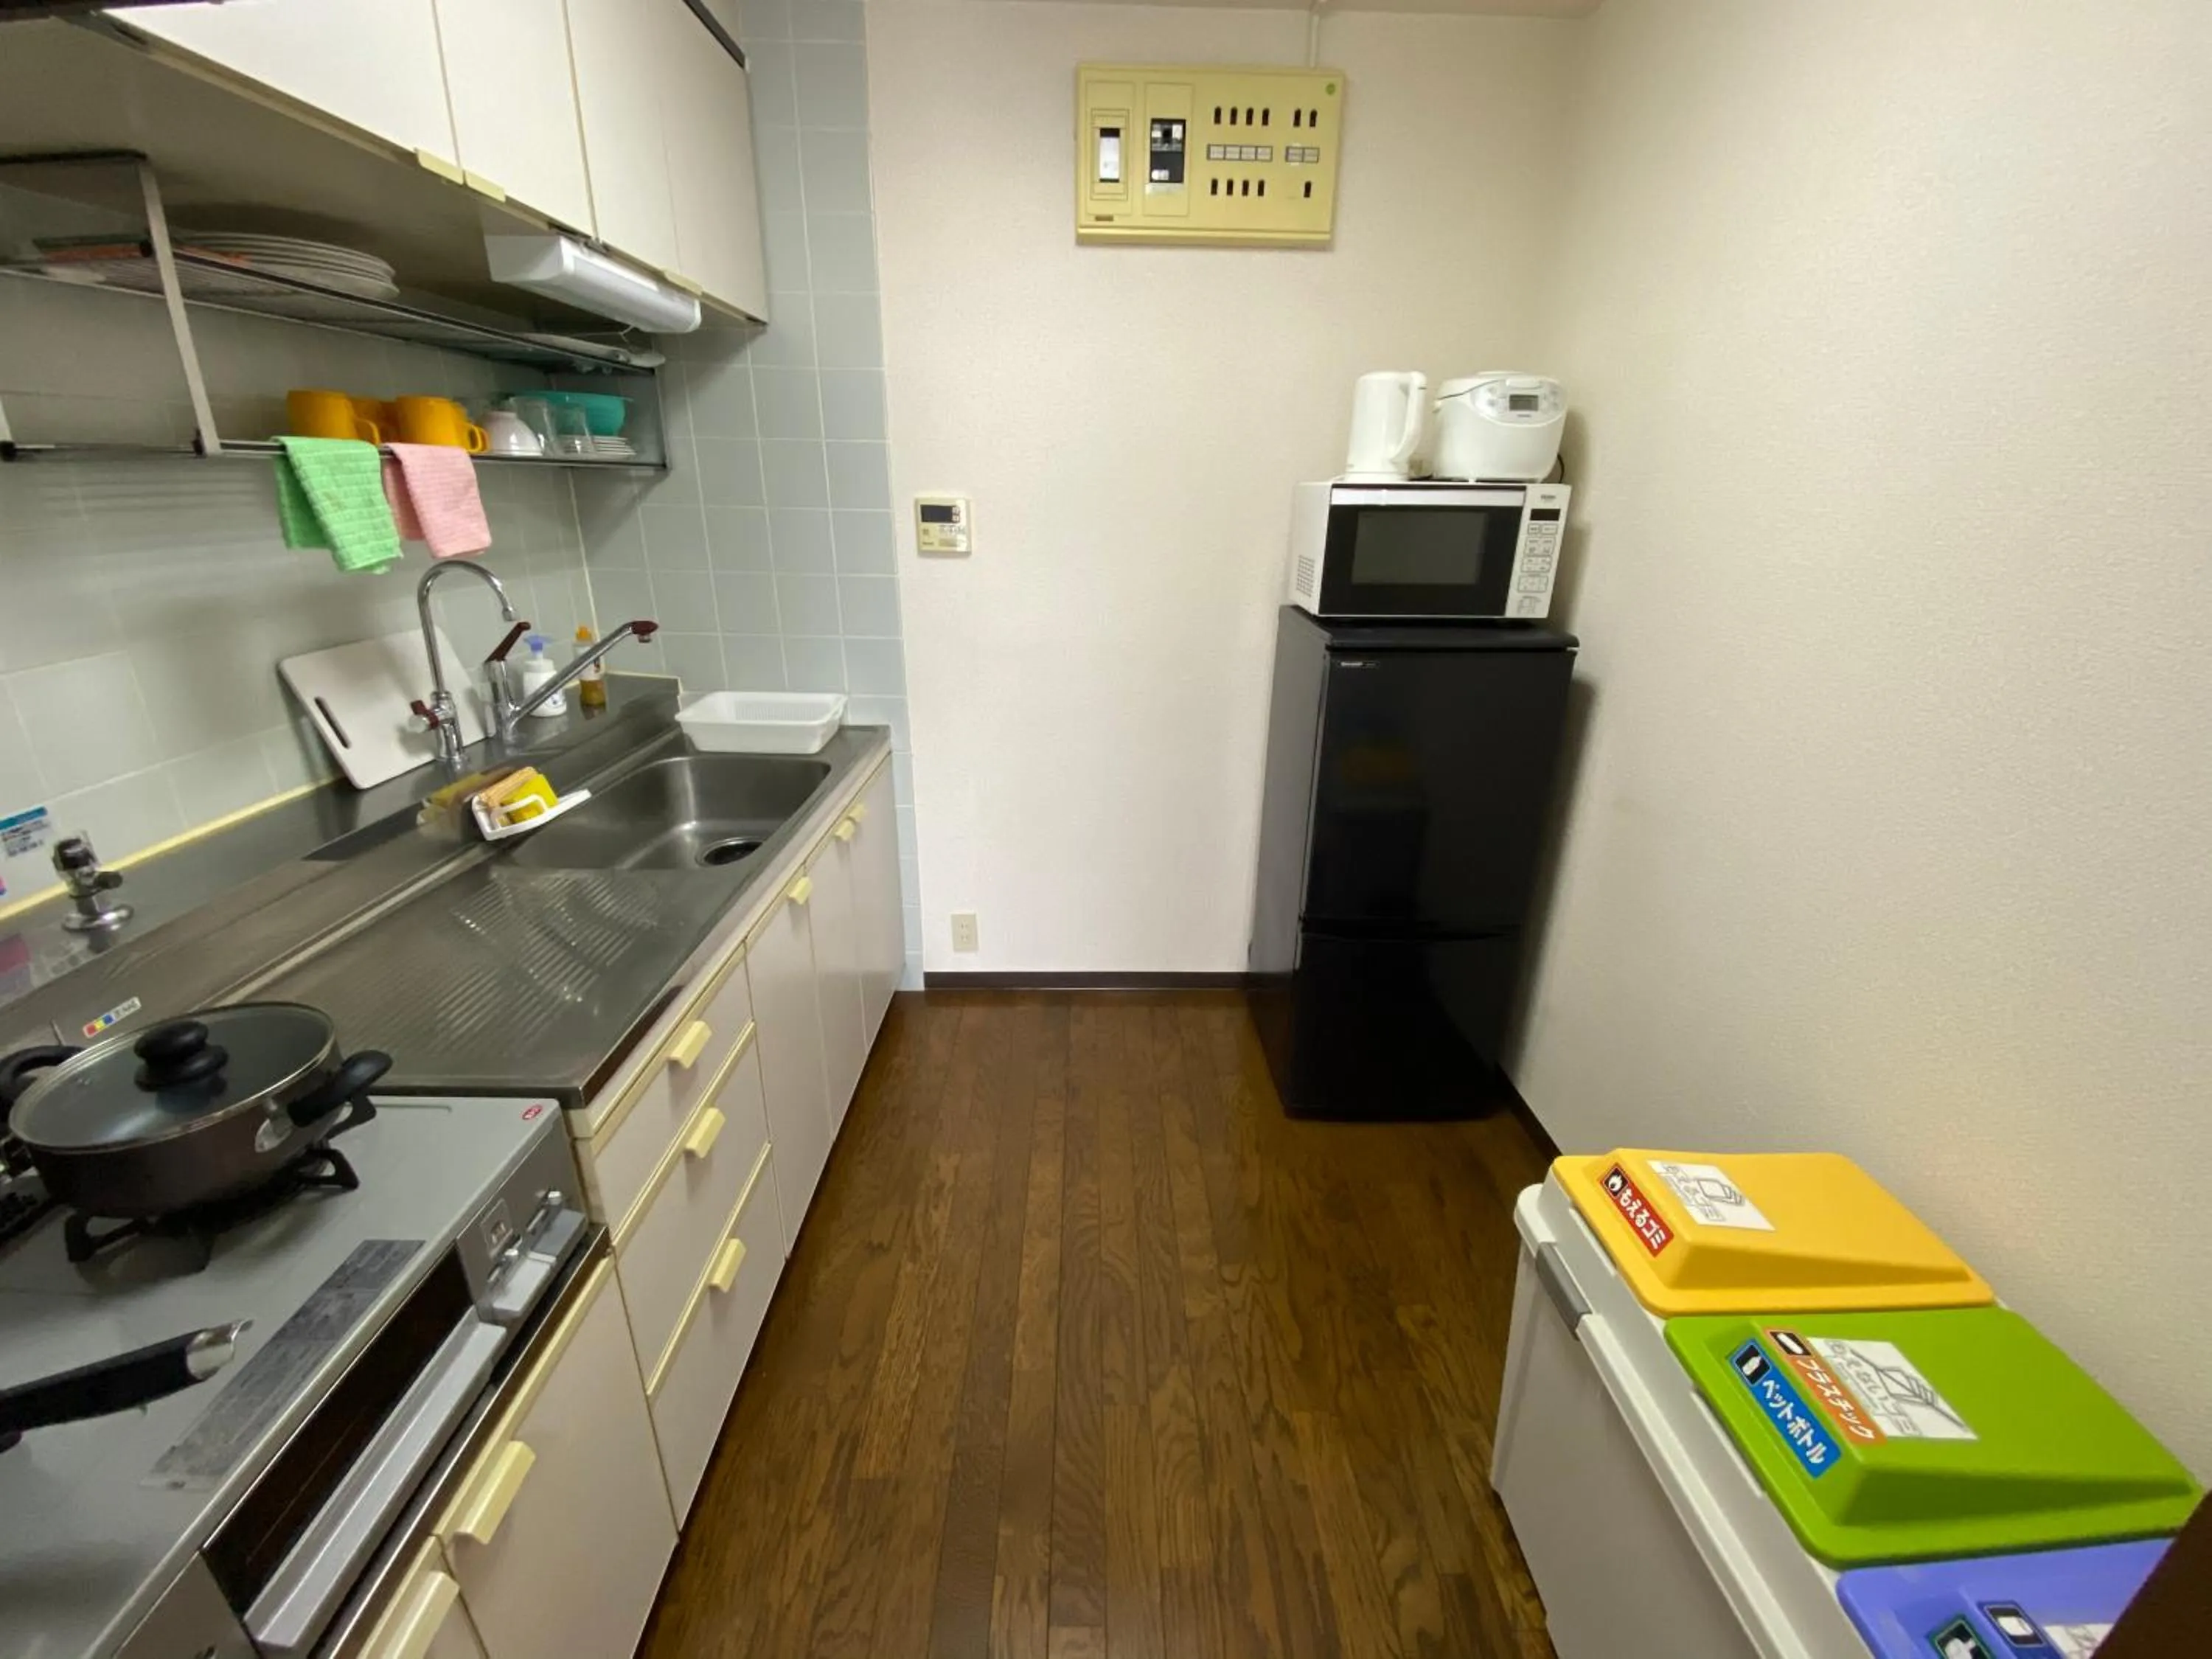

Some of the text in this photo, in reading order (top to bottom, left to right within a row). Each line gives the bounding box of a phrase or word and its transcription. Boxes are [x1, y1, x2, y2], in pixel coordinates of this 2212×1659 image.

[1619, 1187, 1666, 1250] もえるゴミ
[1762, 1379, 1827, 1464] ペットボトル
[1796, 1358, 1876, 1440] プラスチック
